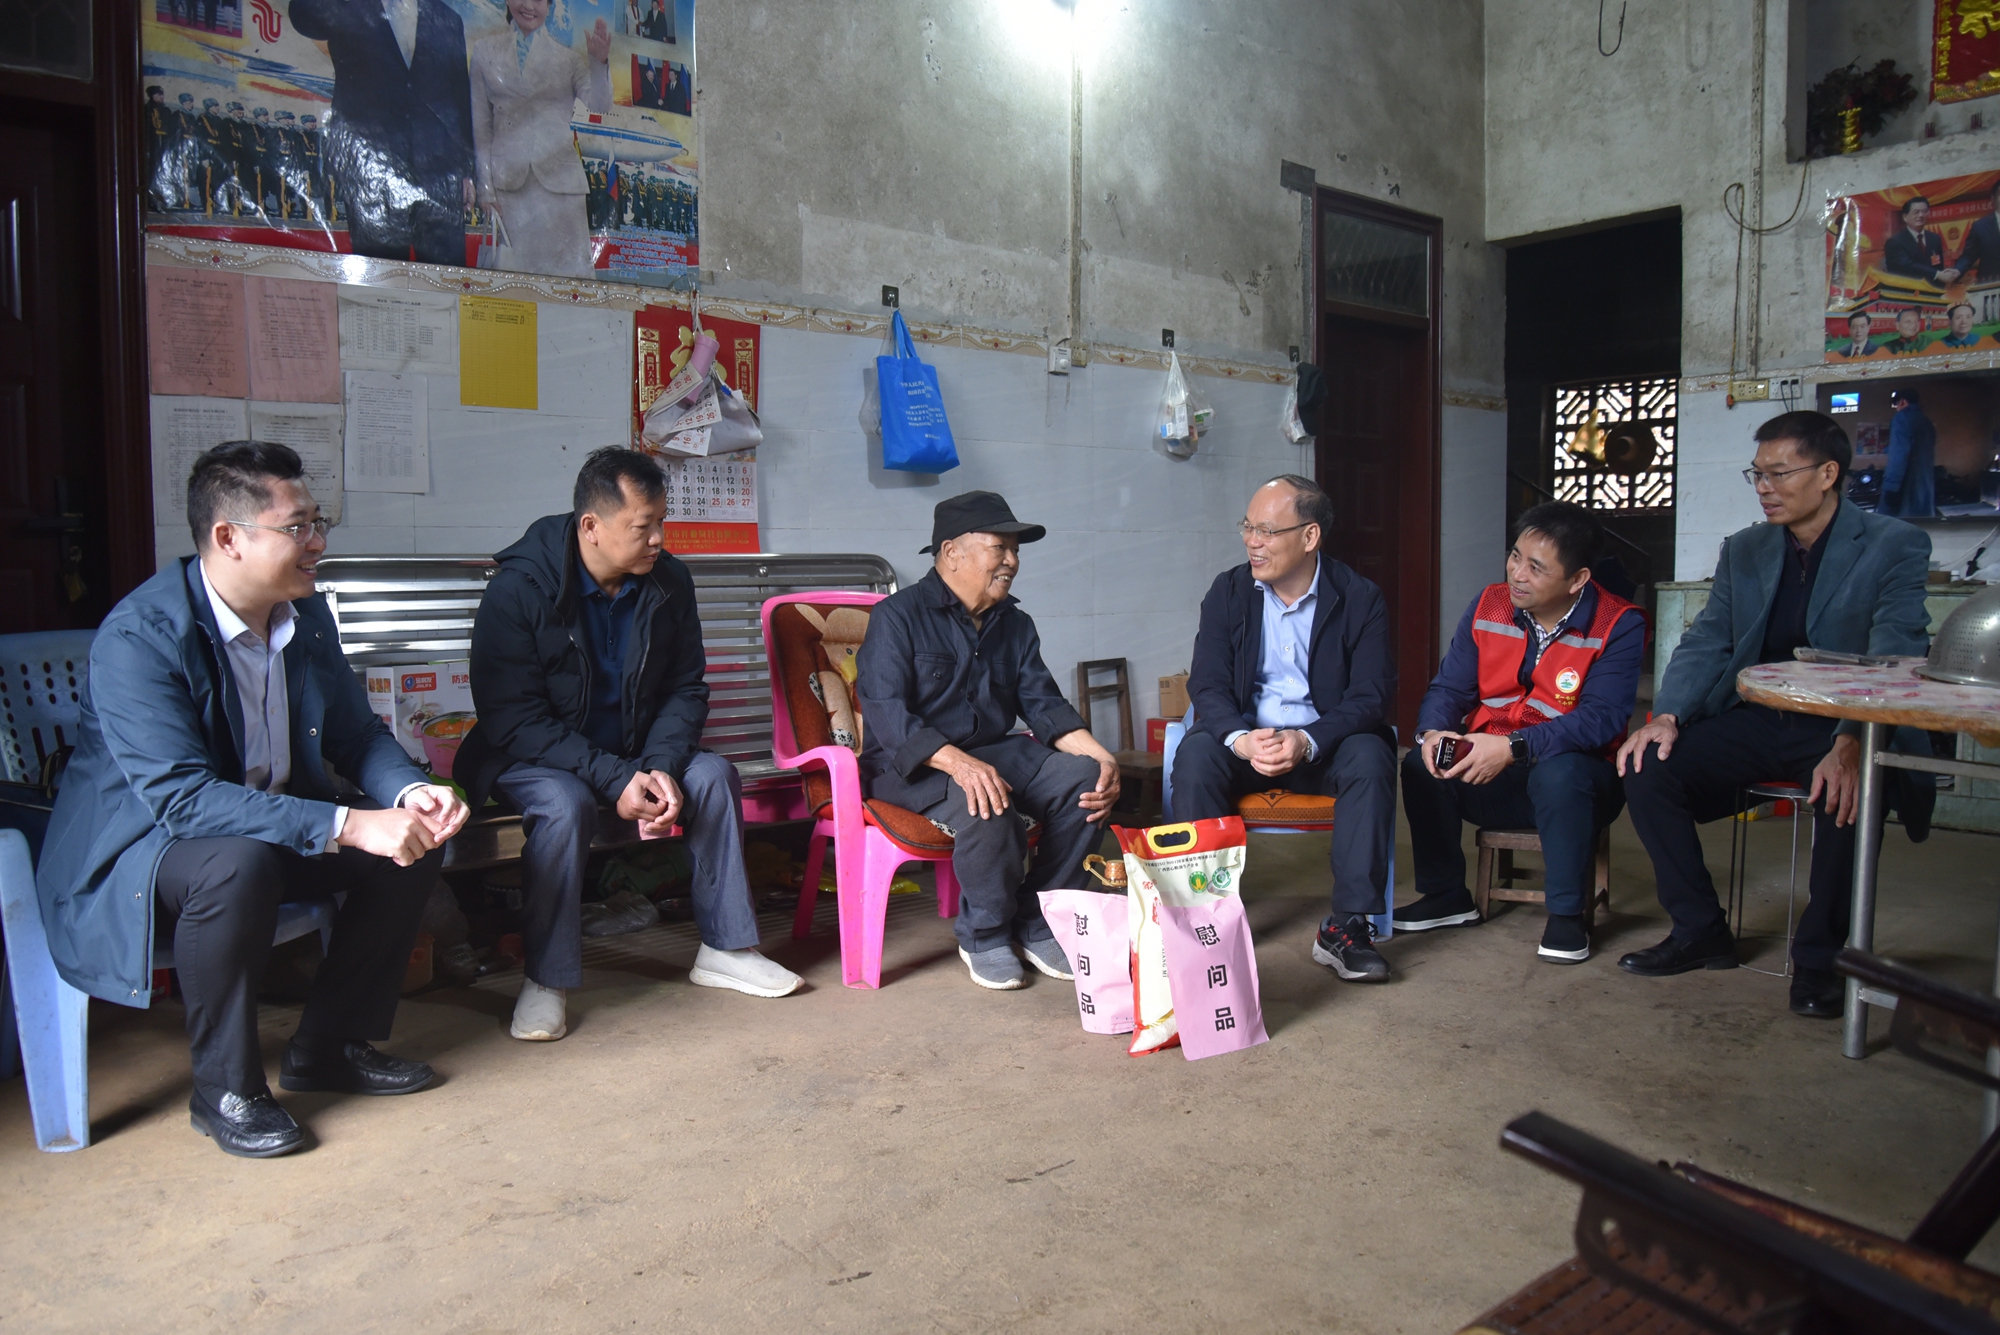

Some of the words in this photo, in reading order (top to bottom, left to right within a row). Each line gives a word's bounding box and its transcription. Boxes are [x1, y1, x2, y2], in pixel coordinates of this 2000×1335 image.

[698, 464, 702, 472] 3
[712, 465, 718, 473] 4
[682, 486, 690, 494] 16
[712, 487, 720, 495] 18
[726, 488, 735, 496] 19
[742, 488, 750, 496] 20
[726, 498, 735, 506] 26
[698, 508, 706, 516] 31
[1554, 693, 1576, 701] 第一书记
[1074, 912, 1096, 1015] 慰问品
[1195, 923, 1236, 1032] 慰问品
